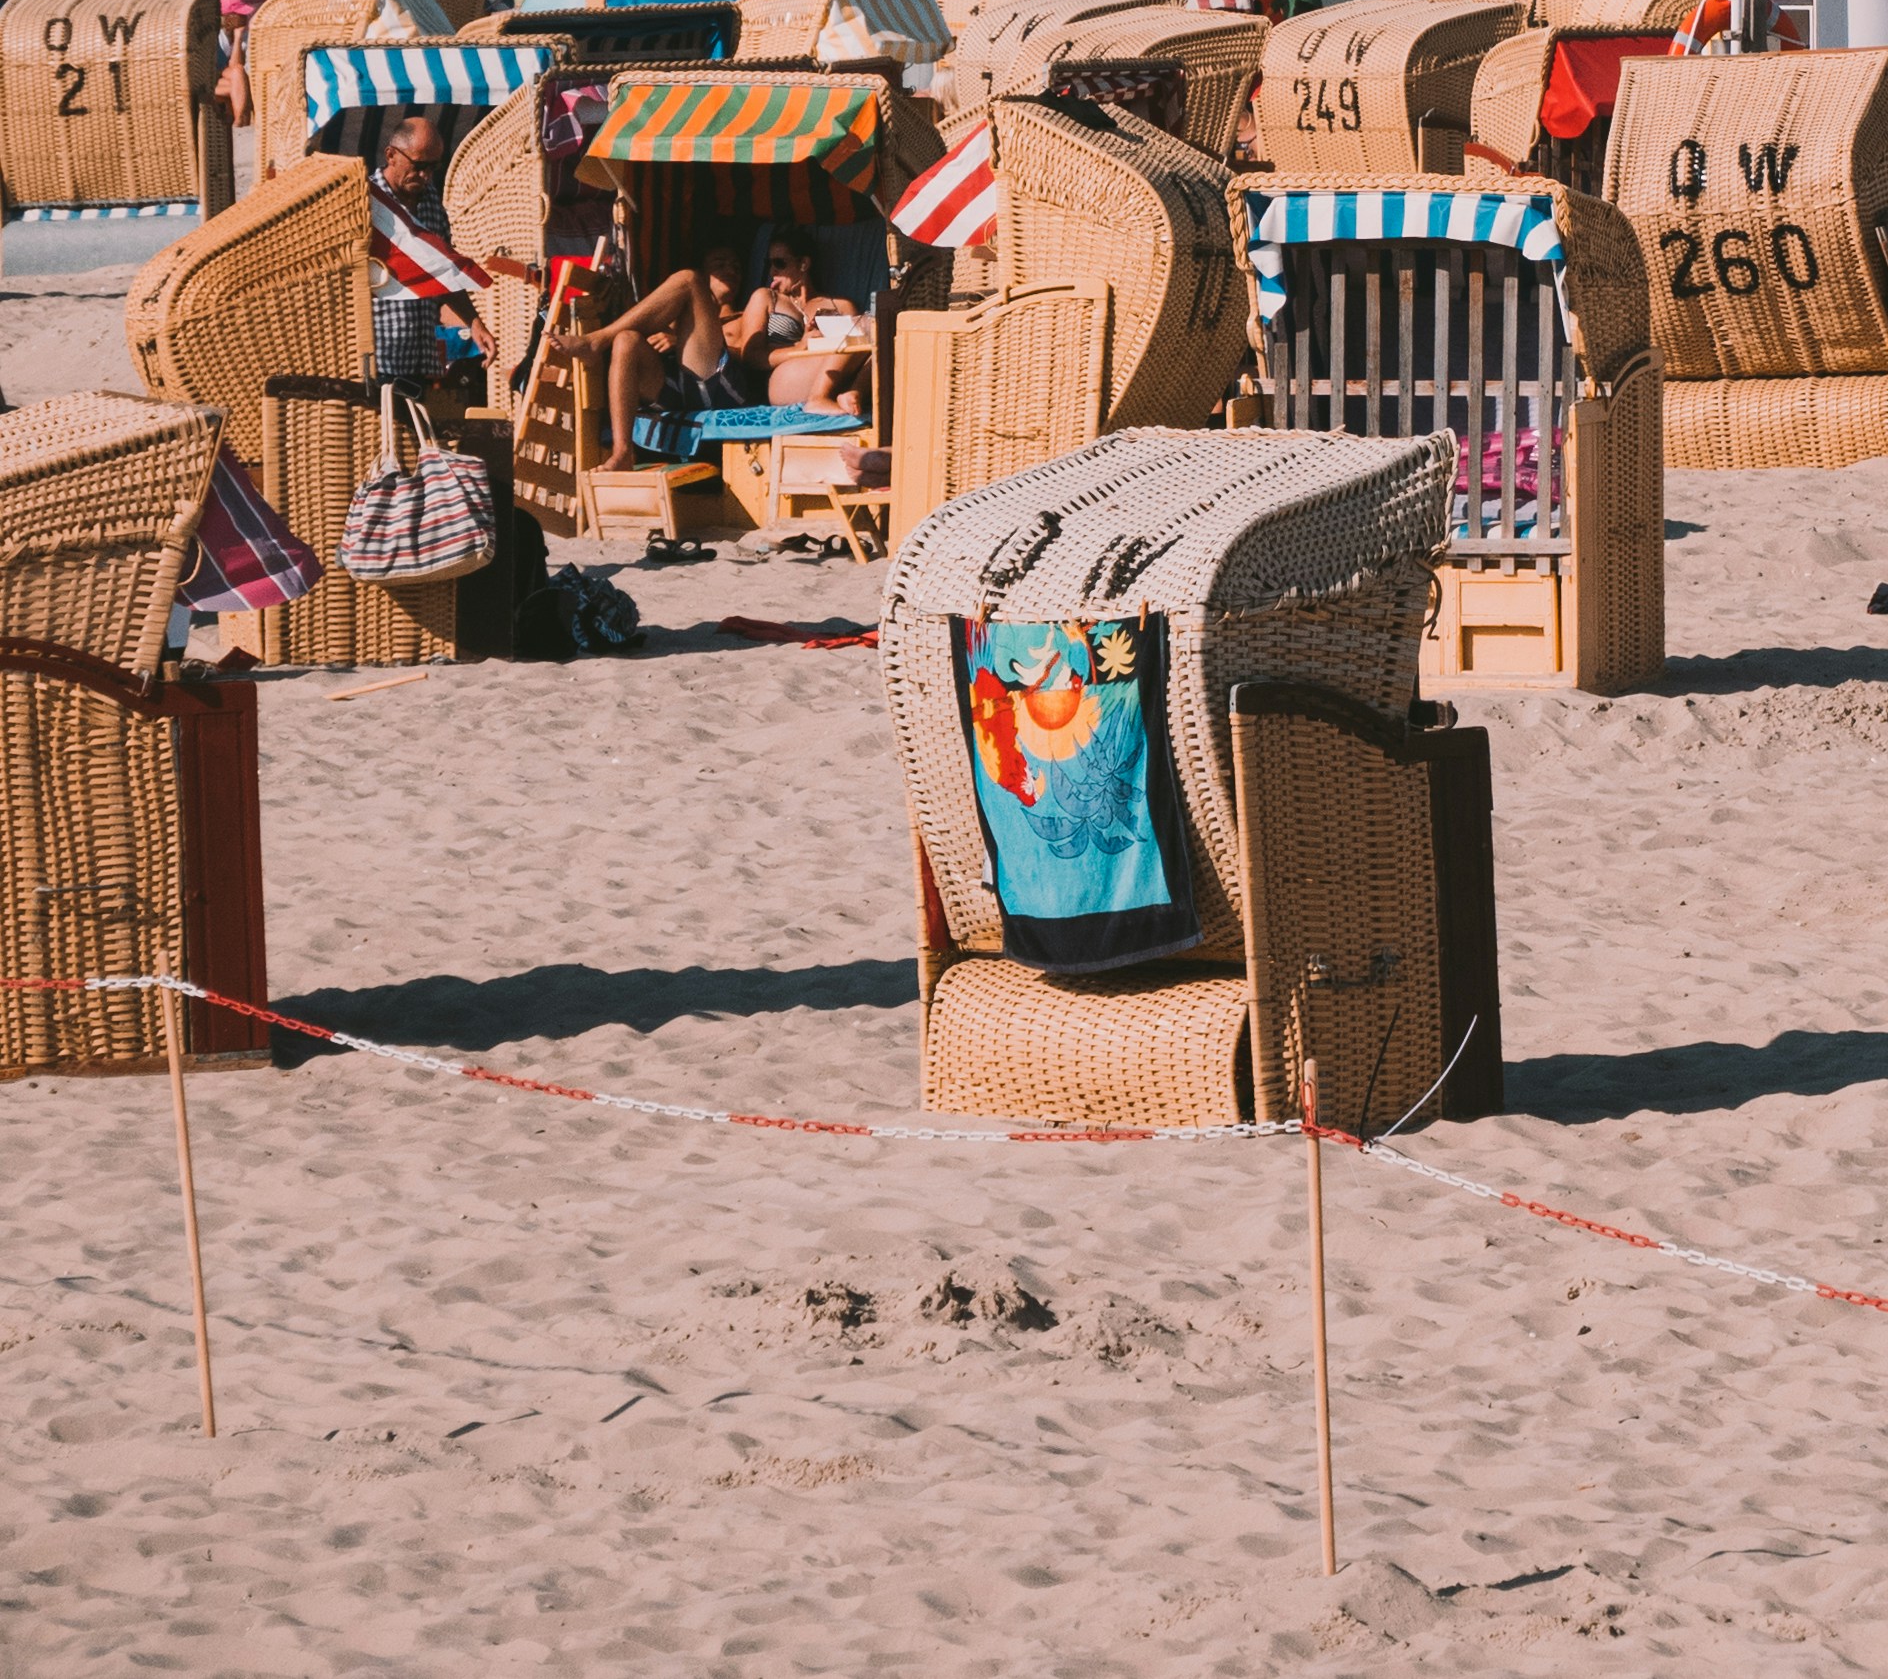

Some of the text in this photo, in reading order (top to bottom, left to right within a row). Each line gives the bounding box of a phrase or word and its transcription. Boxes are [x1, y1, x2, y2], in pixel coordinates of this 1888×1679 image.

[98, 11, 146, 45] W
[56, 63, 128, 117] 21
[1293, 77, 1362, 133] 249
[1739, 143, 1800, 193] W
[1660, 224, 1819, 297] 260
